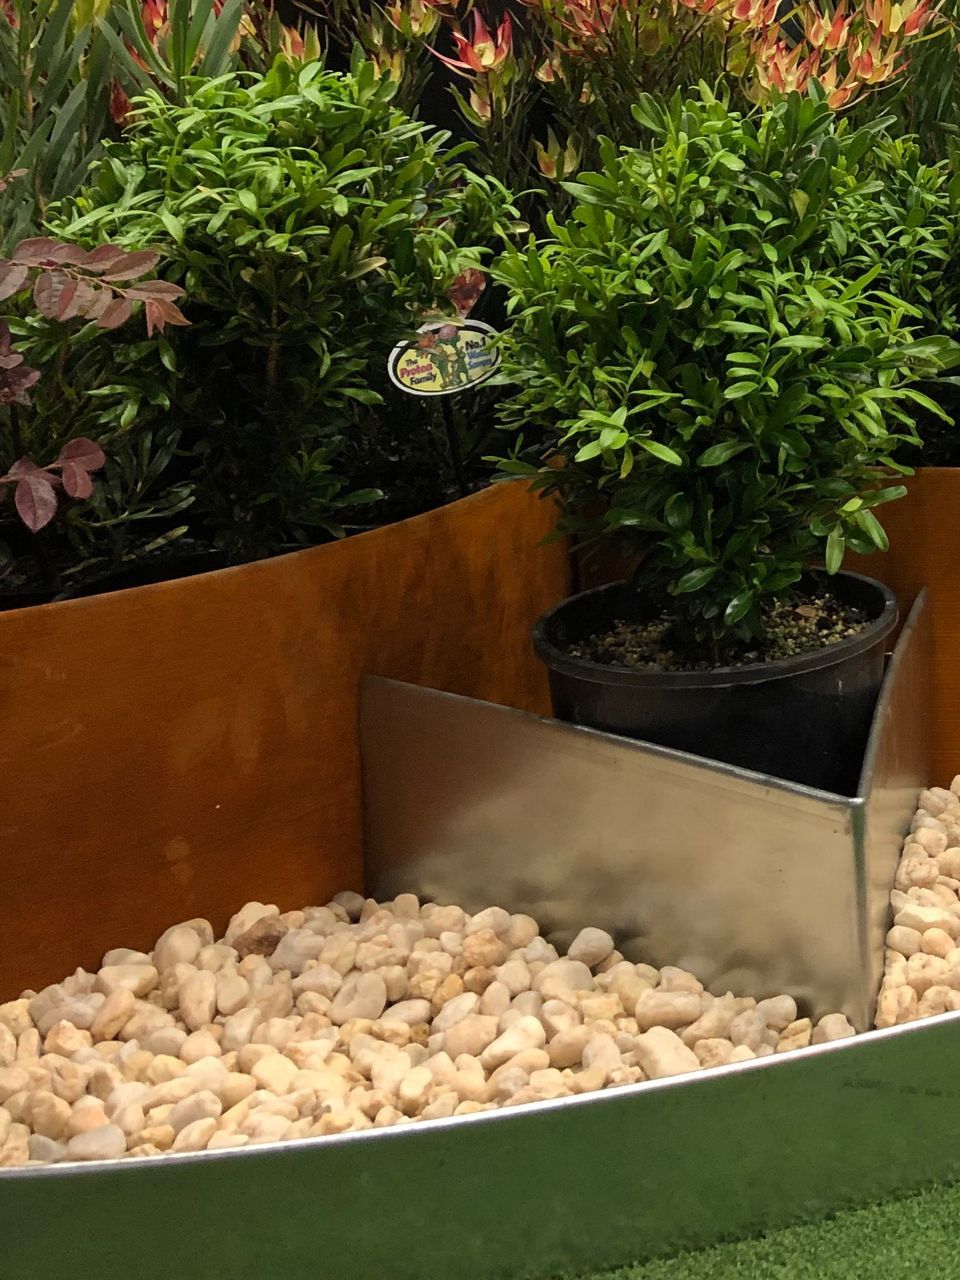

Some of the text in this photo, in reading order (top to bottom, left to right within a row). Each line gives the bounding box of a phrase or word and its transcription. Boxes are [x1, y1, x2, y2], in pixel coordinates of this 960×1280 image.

[465, 337, 486, 351] No.1
[406, 359, 418, 367] The
[400, 364, 433, 379] Protea
[410, 372, 437, 386] Family
